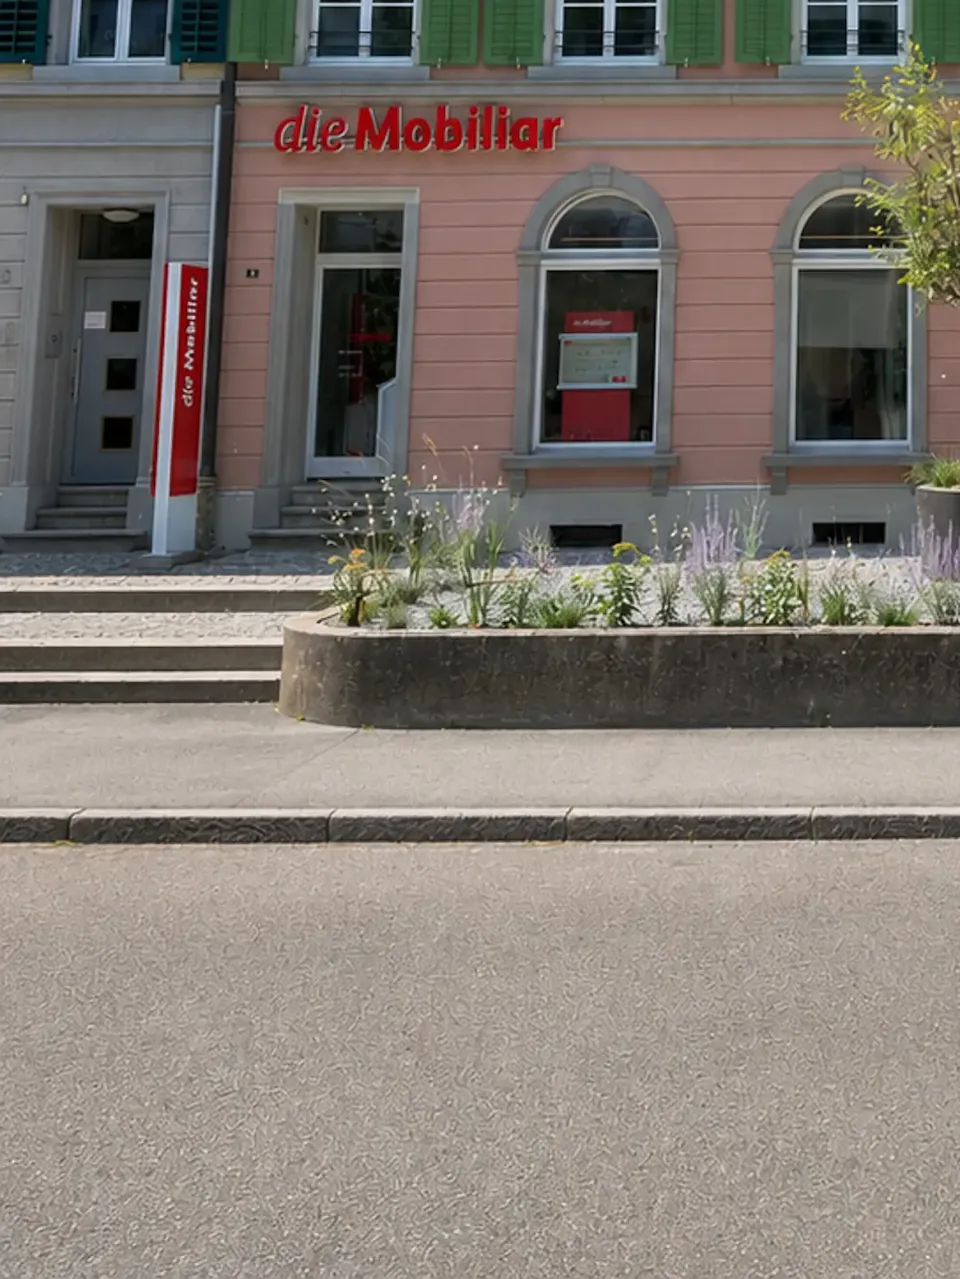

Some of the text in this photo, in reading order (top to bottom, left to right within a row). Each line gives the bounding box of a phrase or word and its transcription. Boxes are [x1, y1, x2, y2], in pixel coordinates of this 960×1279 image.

[273, 105, 564, 153] die Mobiliar
[184, 277, 198, 370] Mobiliar
